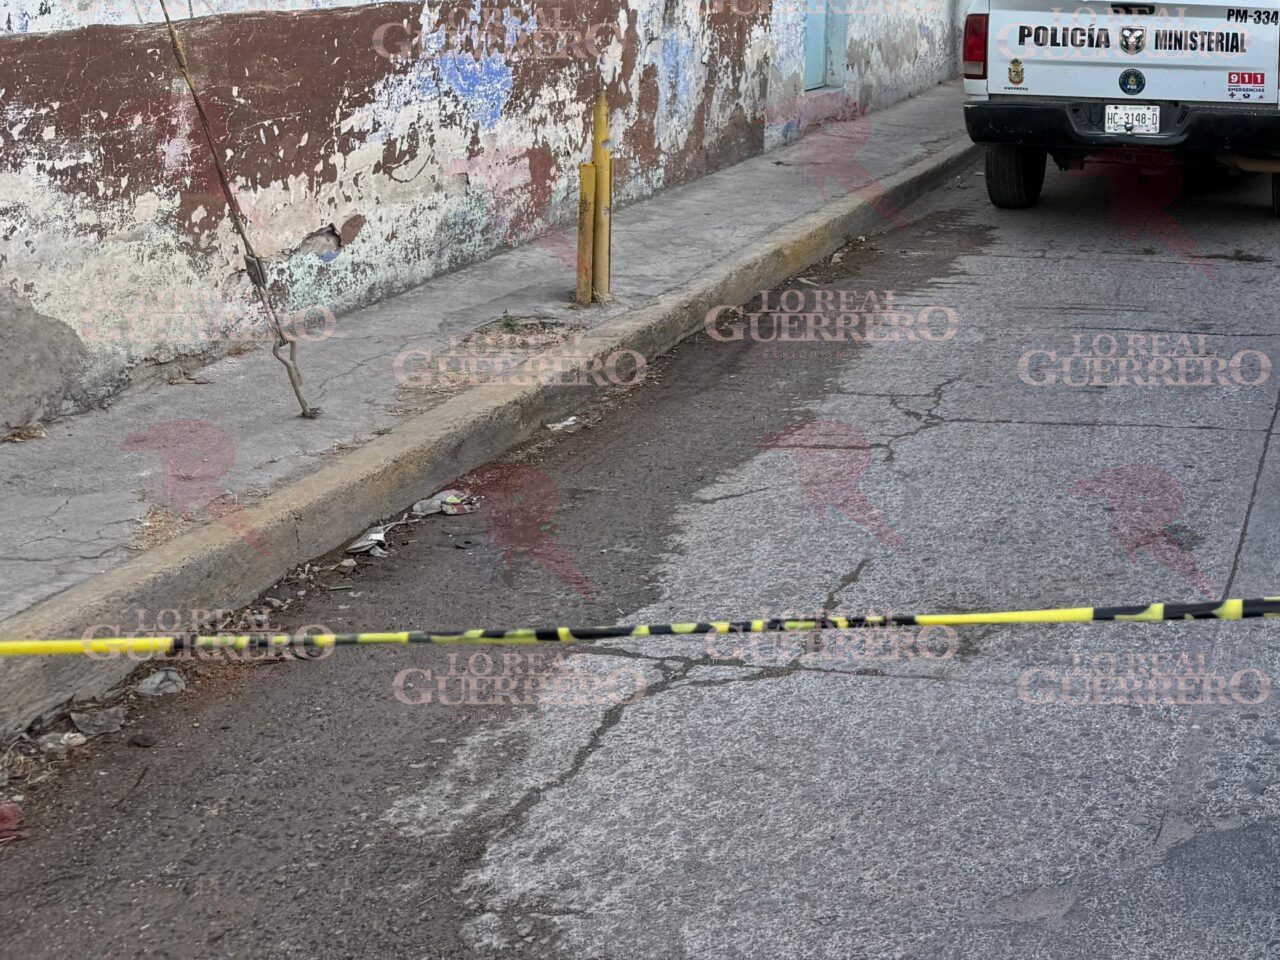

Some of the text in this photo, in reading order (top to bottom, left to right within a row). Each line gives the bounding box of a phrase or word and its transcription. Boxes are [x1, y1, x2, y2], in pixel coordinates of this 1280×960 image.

[1227, 8, 1279, 26] PM-334
[1018, 24, 1247, 53] POLICÍA MINISTERIAL
[1230, 73, 1262, 84] 911
[1107, 112, 1158, 126] HC-3148-D
